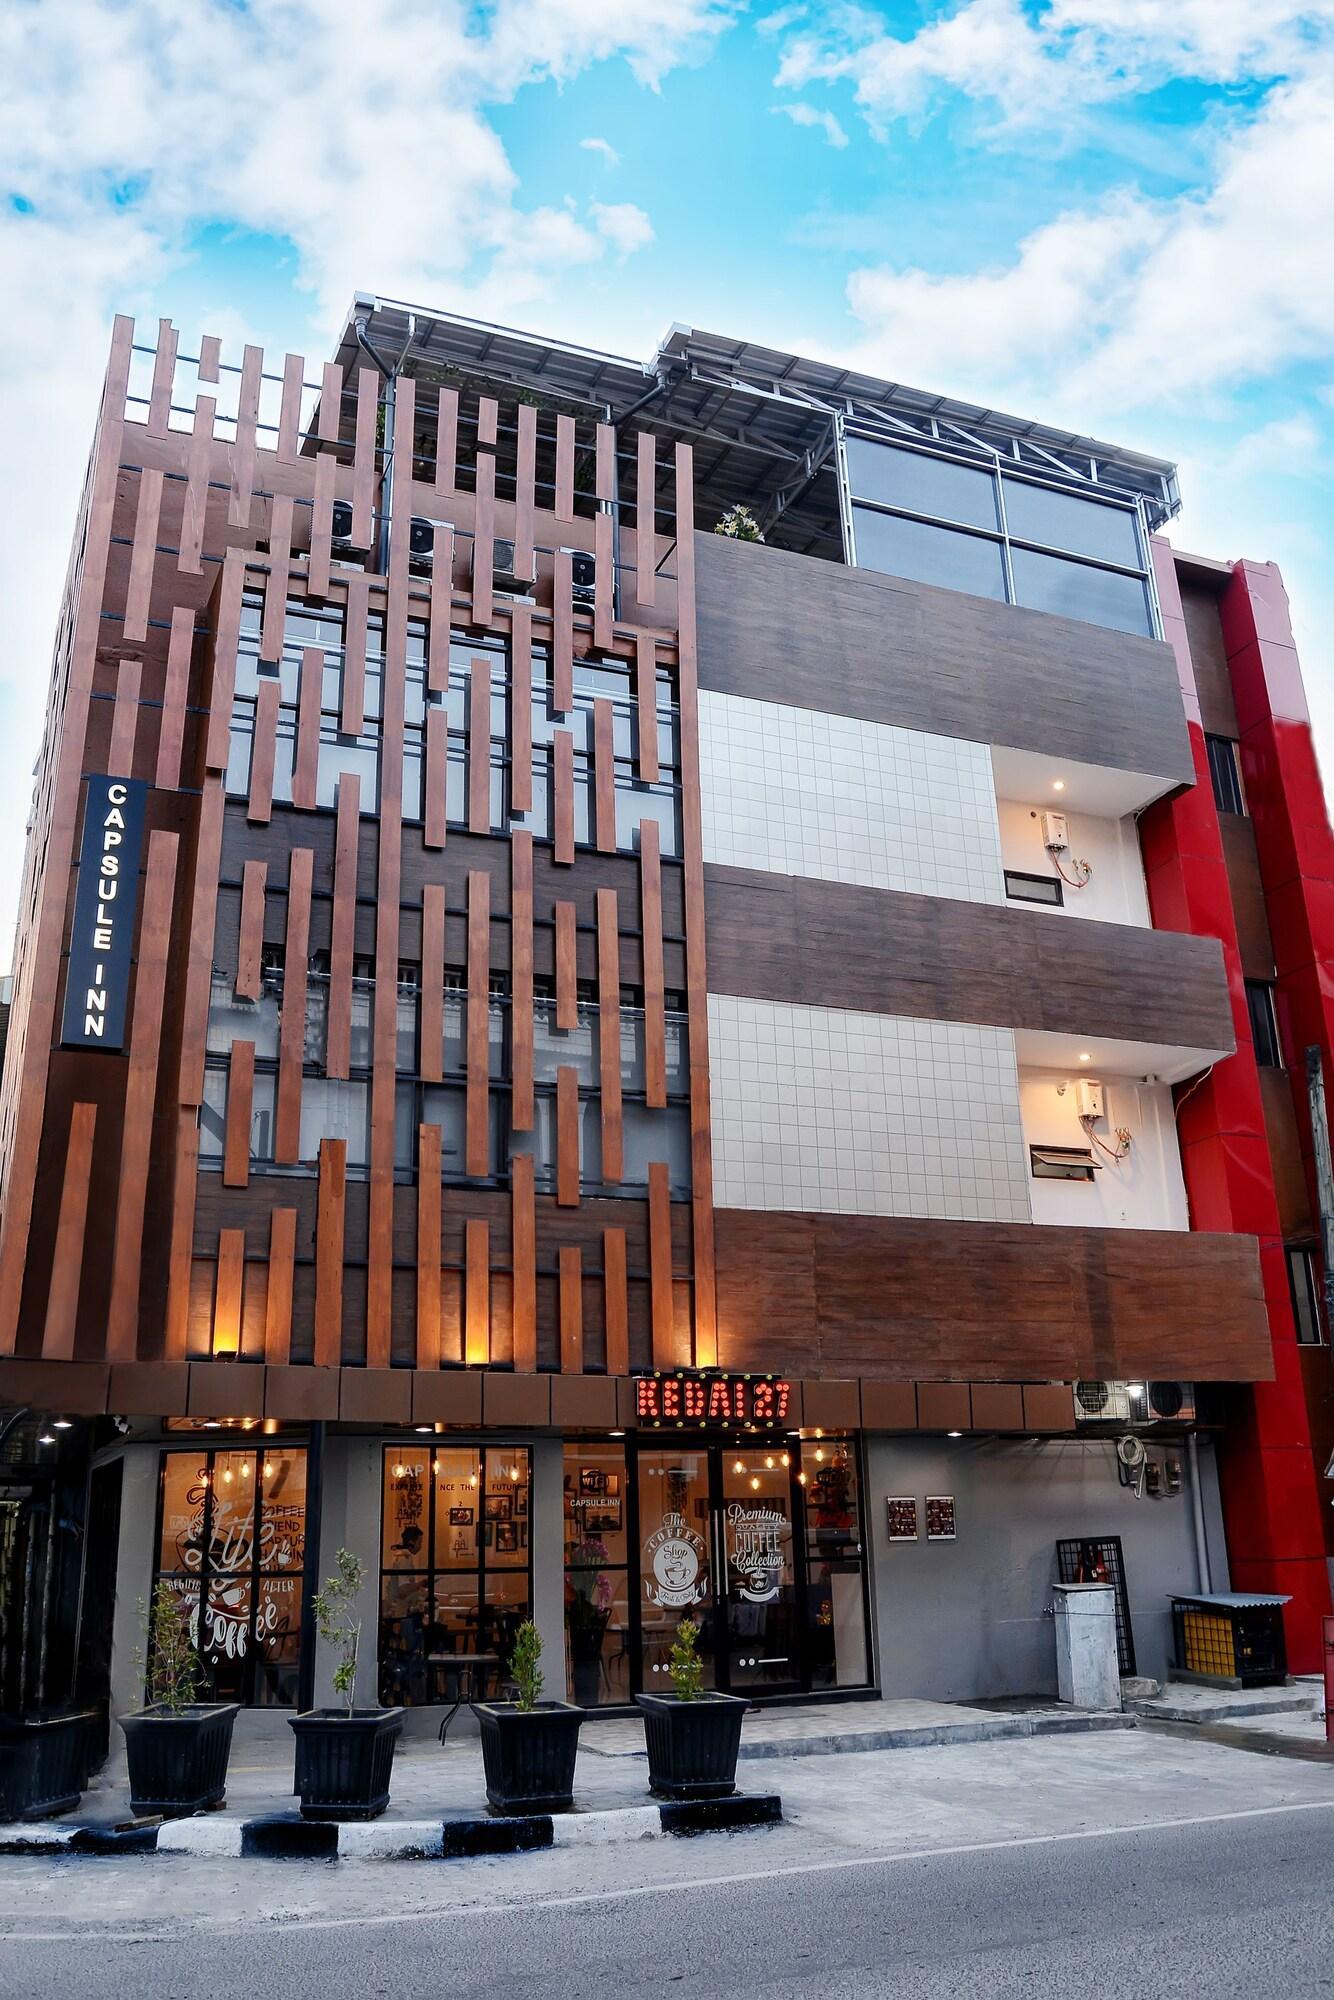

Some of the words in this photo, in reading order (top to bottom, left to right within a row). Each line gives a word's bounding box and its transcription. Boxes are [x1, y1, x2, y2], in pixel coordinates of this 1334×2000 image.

[92, 783, 128, 951] CAPSULE
[83, 963, 107, 1038] INN
[637, 1380, 744, 1418] KEDAI
[753, 1382, 790, 1418] 27
[570, 1499, 606, 1508] CAPSULE
[607, 1498, 621, 1507] INN
[728, 1503, 787, 1526] Premium
[663, 1512, 687, 1528] The
[649, 1527, 702, 1549] COFFEE
[735, 1531, 782, 1554] COFFEE
[663, 1543, 689, 1561] Shop
[730, 1550, 786, 1574] Collection
